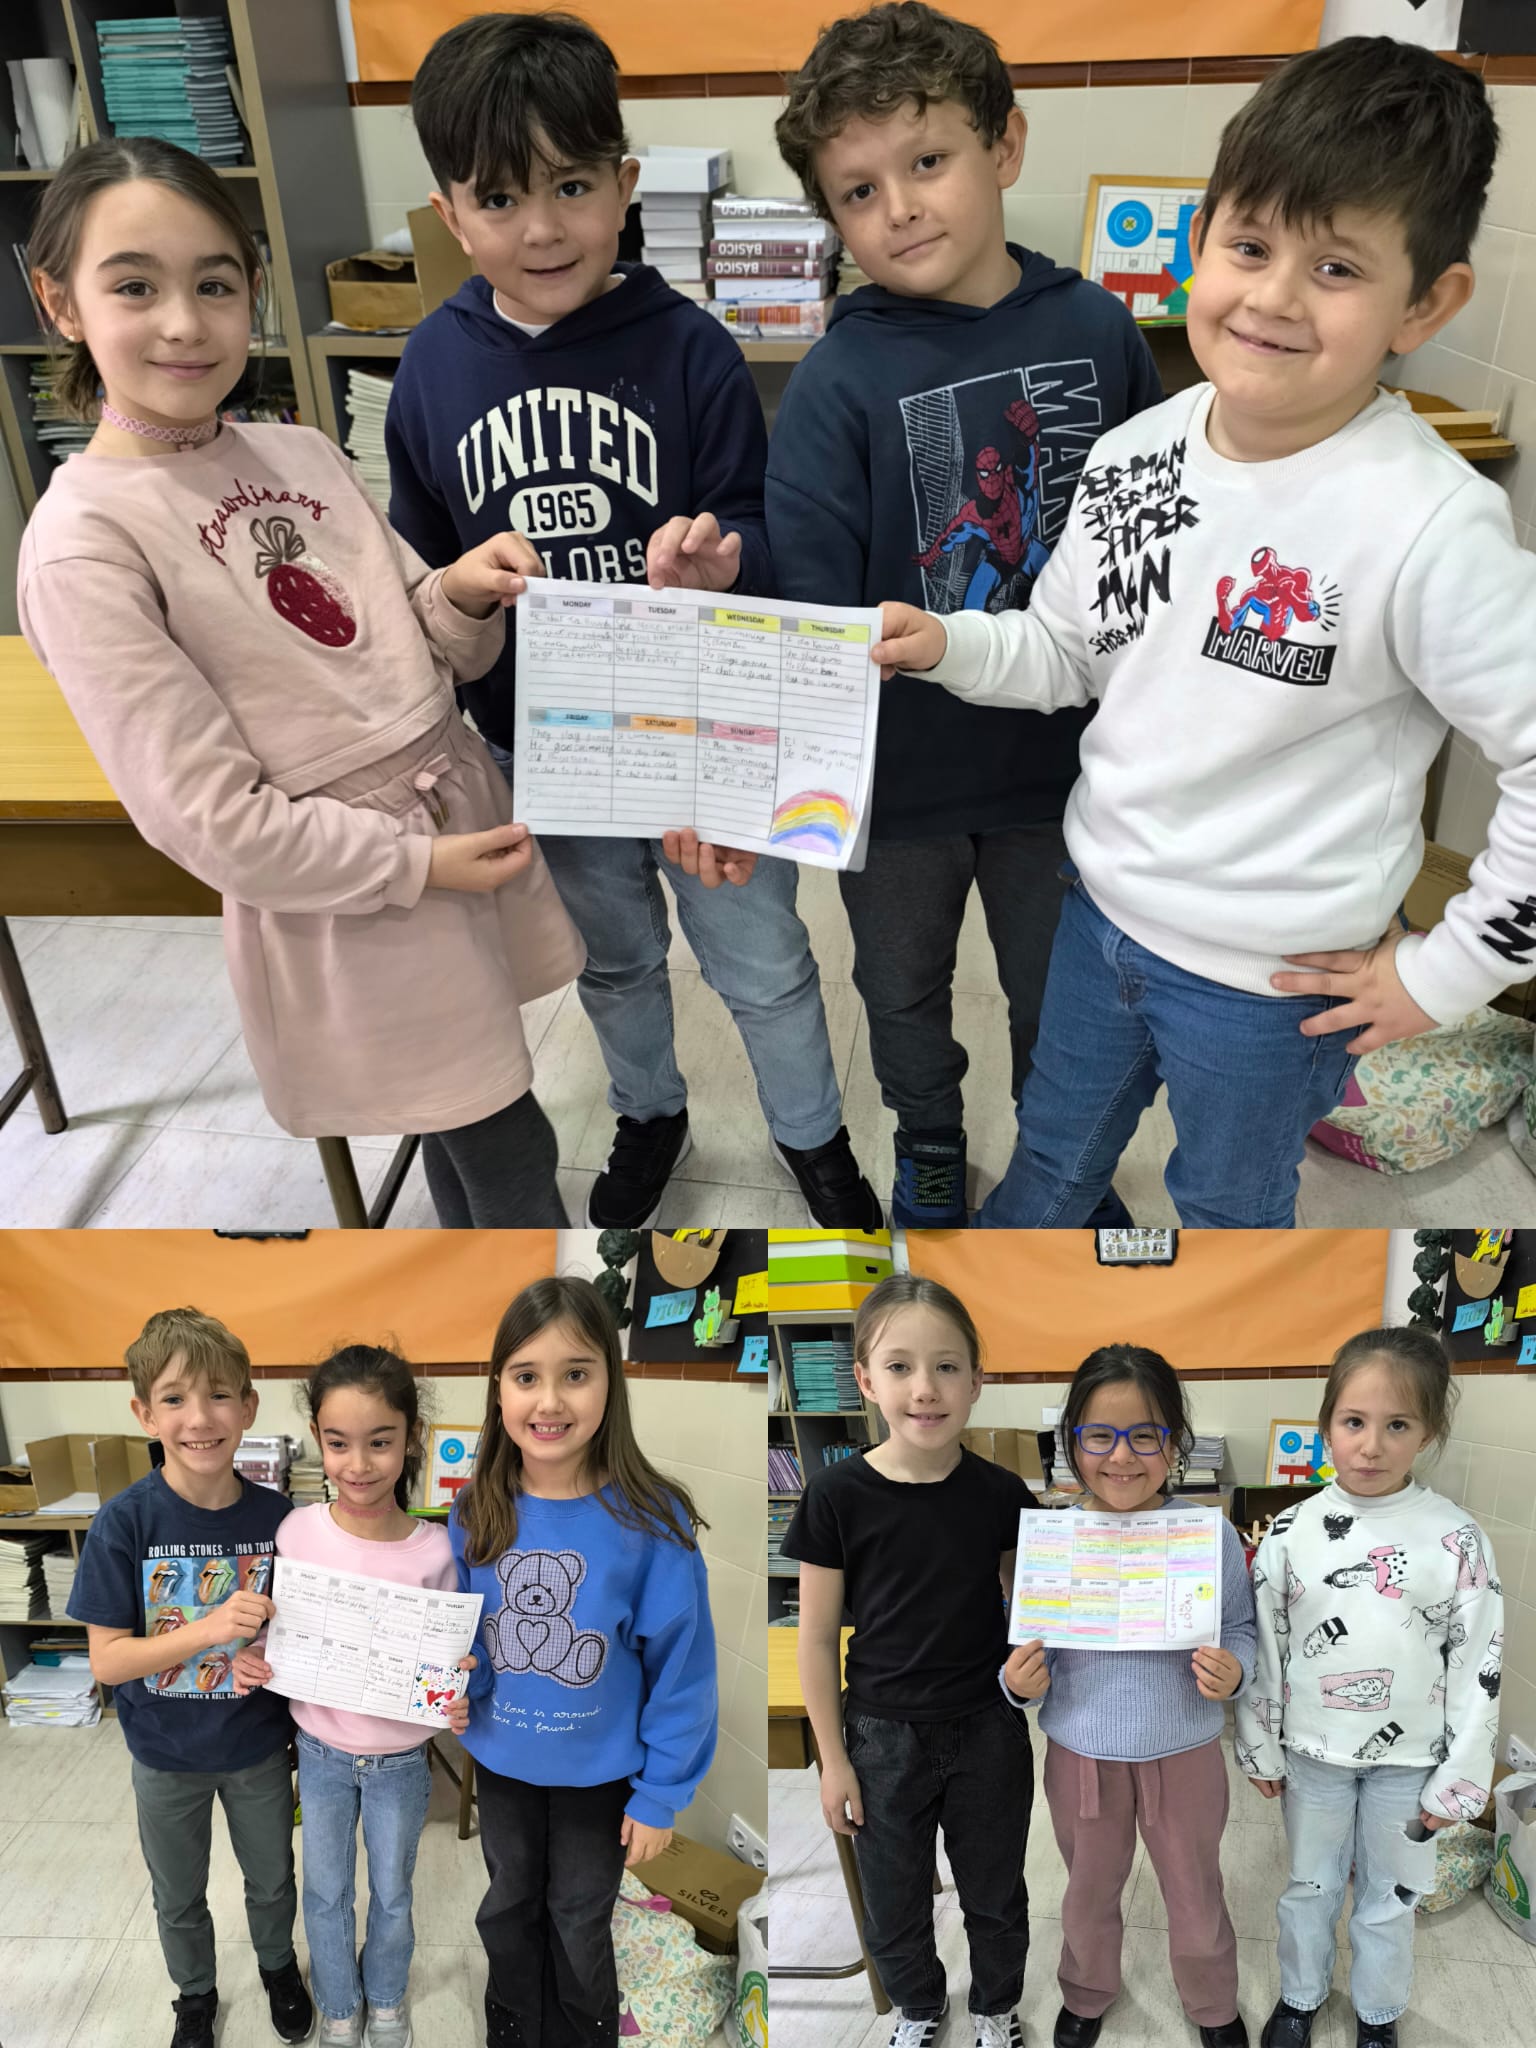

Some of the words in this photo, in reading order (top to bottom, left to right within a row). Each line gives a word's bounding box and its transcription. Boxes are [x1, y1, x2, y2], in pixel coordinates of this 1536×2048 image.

[457, 387, 659, 515] UNITED
[523, 489, 597, 533] 1965
[1091, 494, 1201, 568] SPIDER
[542, 538, 647, 582] LORS
[1089, 544, 1174, 623] MAN
[562, 600, 592, 609] MONDAY
[648, 606, 677, 615] TUESDAY
[726, 613, 765, 625] WEDNESDAY
[811, 625, 846, 634] THURSDAY
[1208, 633, 1328, 682] MARVEL
[565, 713, 589, 721] FRIDAY
[645, 719, 677, 728] SATURDAY
[730, 727, 755, 736] SUNDAY
[148, 1544, 186, 1558] ROLLING
[189, 1544, 223, 1557] STONES
[502, 1701, 527, 1715] love
[533, 1709, 545, 1718] is
[553, 1705, 602, 1719] around
[491, 1711, 511, 1726] love
[515, 1720, 528, 1729] is
[677, 1888, 729, 1918] SILVER
